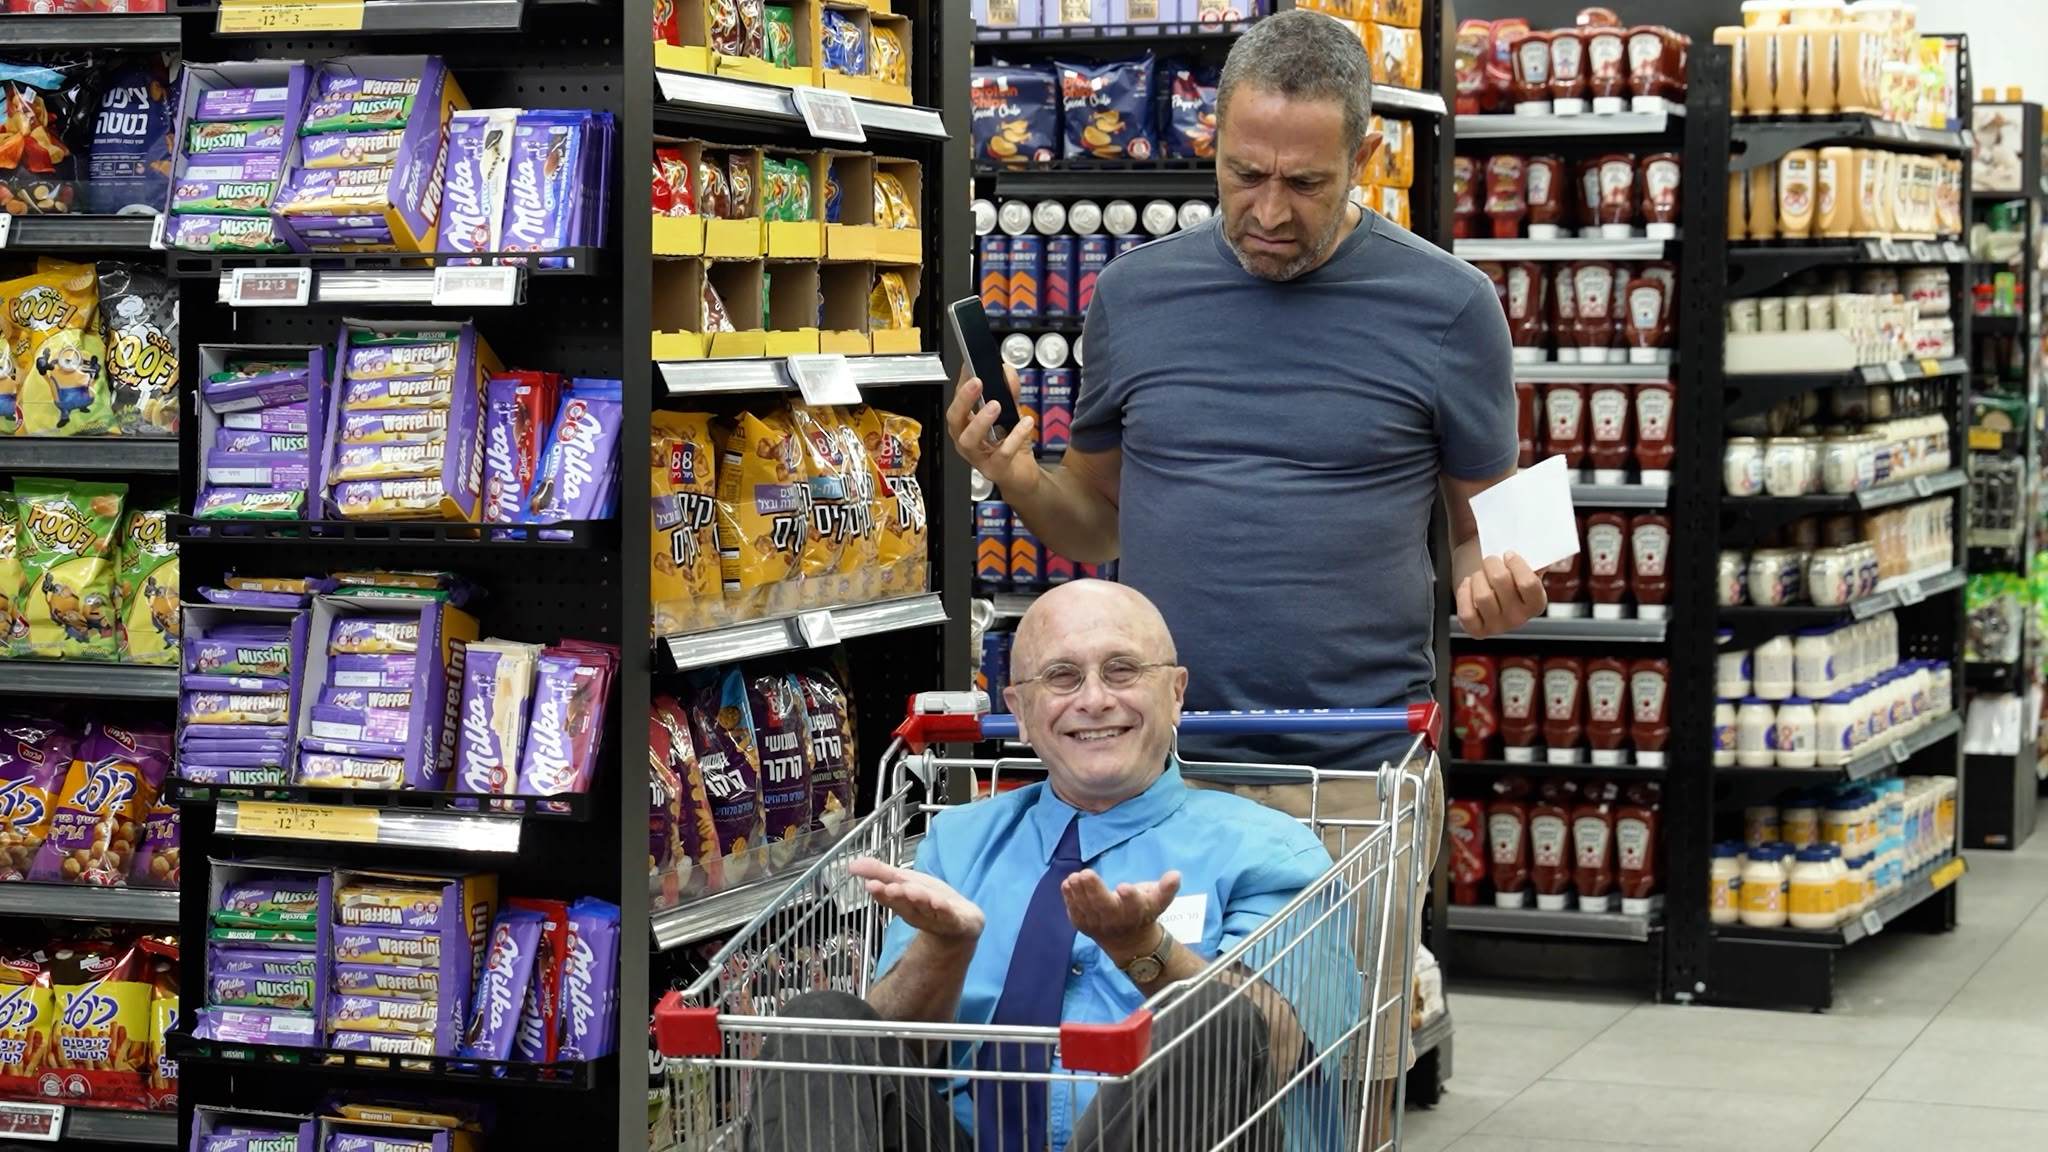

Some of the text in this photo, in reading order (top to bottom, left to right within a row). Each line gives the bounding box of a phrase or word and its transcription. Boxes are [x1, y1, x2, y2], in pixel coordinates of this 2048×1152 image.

[263, 14, 300, 26] 12 3
[95, 111, 148, 136] בטטה
[217, 183, 272, 201] Nussini
[509, 157, 547, 243] Milka
[447, 155, 486, 252] Milka
[257, 279, 271, 291] 12
[388, 375, 452, 396] Waffelini
[381, 410, 447, 432] Waffelini
[562, 411, 602, 504] Milka
[375, 623, 419, 642] Waffel
[237, 648, 288, 666] Nussini
[366, 691, 412, 709] Waffel
[438, 637, 467, 772] Waffelini
[464, 693, 499, 794] Milka
[528, 698, 570, 797] Milka
[763, 754, 804, 783] קרקר
[278, 818, 316, 830] 12 3
[272, 890, 318, 905] Nussin
[377, 937, 441, 957] Waffelini
[255, 980, 309, 998] Nussini
[374, 974, 438, 992] Waffelini
[490, 936, 519, 1036] Milka
[567, 936, 595, 1041] Milka
[13, 1114, 27, 1124] 15
